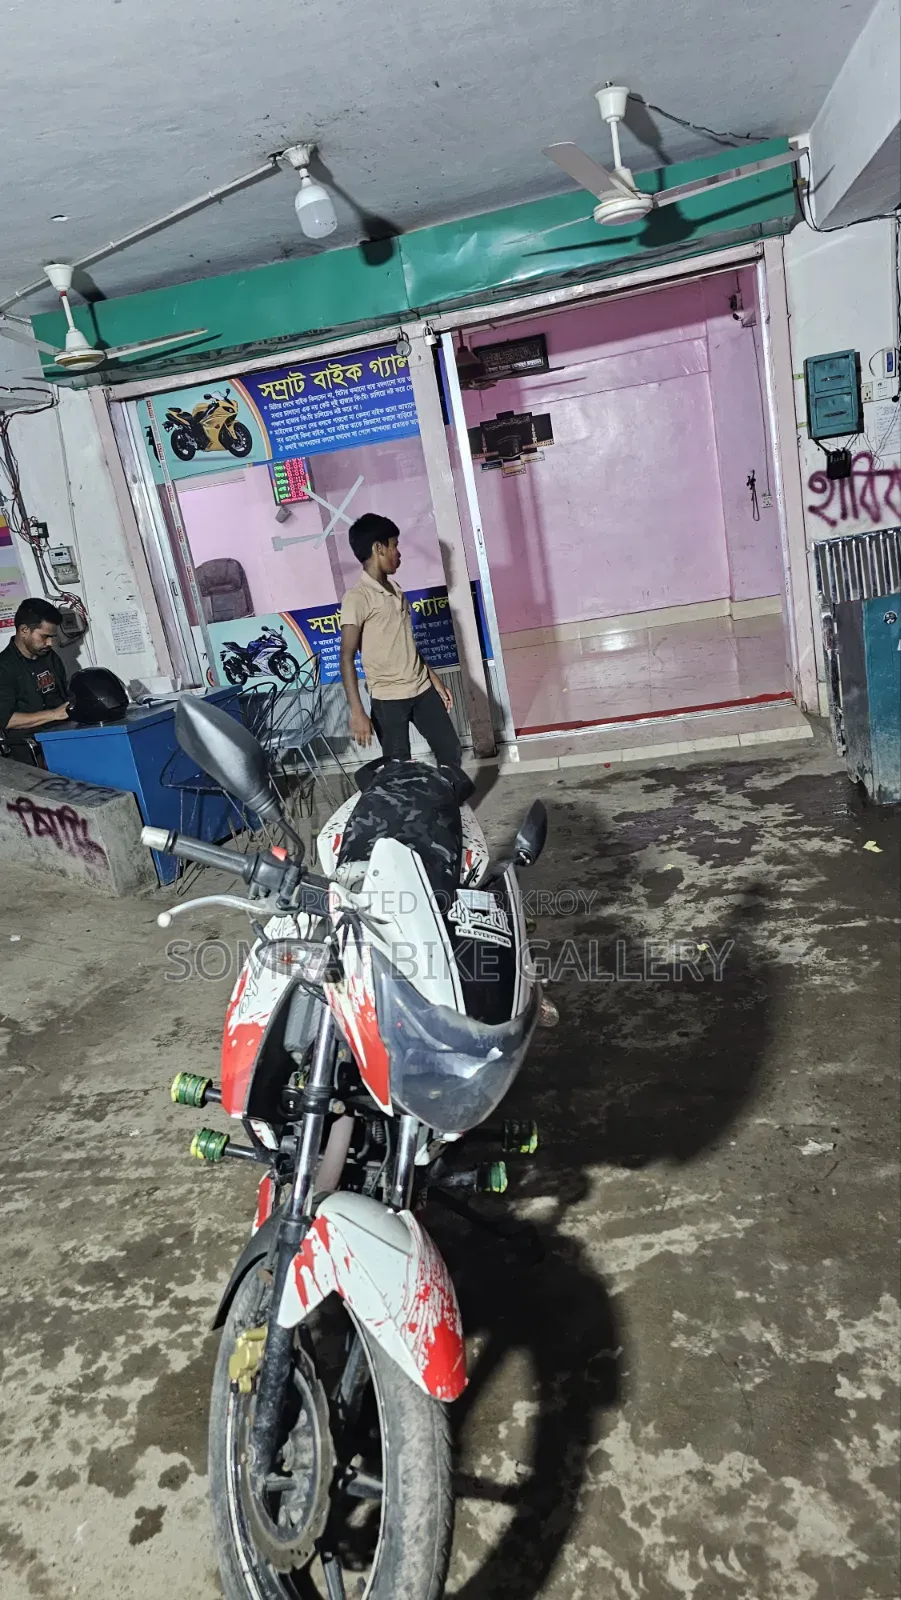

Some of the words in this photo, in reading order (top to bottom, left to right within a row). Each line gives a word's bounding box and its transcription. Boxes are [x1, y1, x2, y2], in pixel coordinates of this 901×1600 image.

[257, 371, 306, 400] সম্রাট
[310, 361, 363, 389] বাইক
[306, 608, 341, 634] সম্রা
